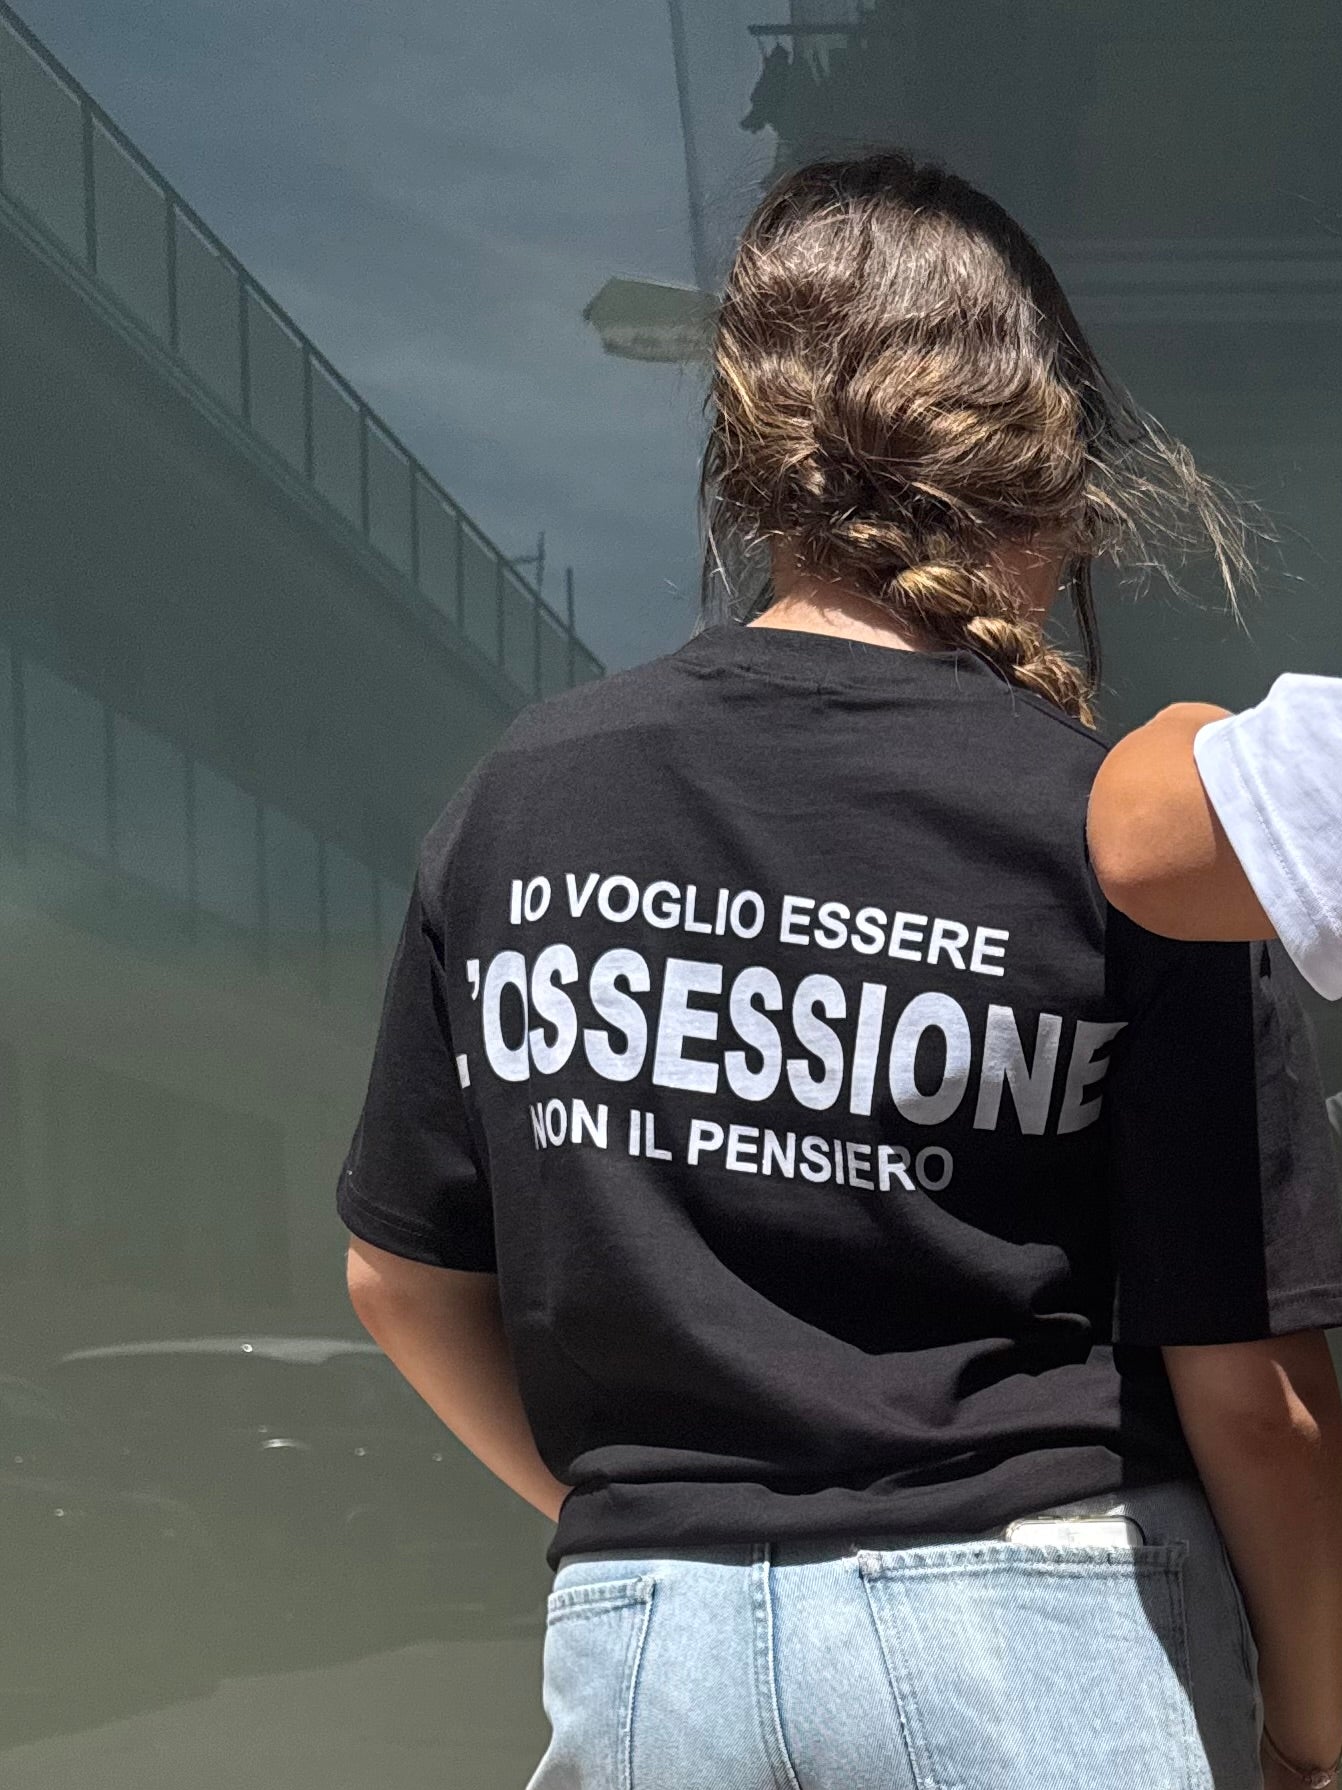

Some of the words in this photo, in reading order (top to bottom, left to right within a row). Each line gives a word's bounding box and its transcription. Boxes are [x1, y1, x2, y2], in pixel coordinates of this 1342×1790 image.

[509, 875, 551, 925] IO
[565, 873, 765, 938] VOGLIO
[779, 894, 1010, 977] ESSERE
[456, 943, 1129, 1136] 'OSSESSIONE
[530, 1098, 608, 1151] NON
[628, 1108, 673, 1162] IL
[687, 1118, 954, 1194] PENSIERO
